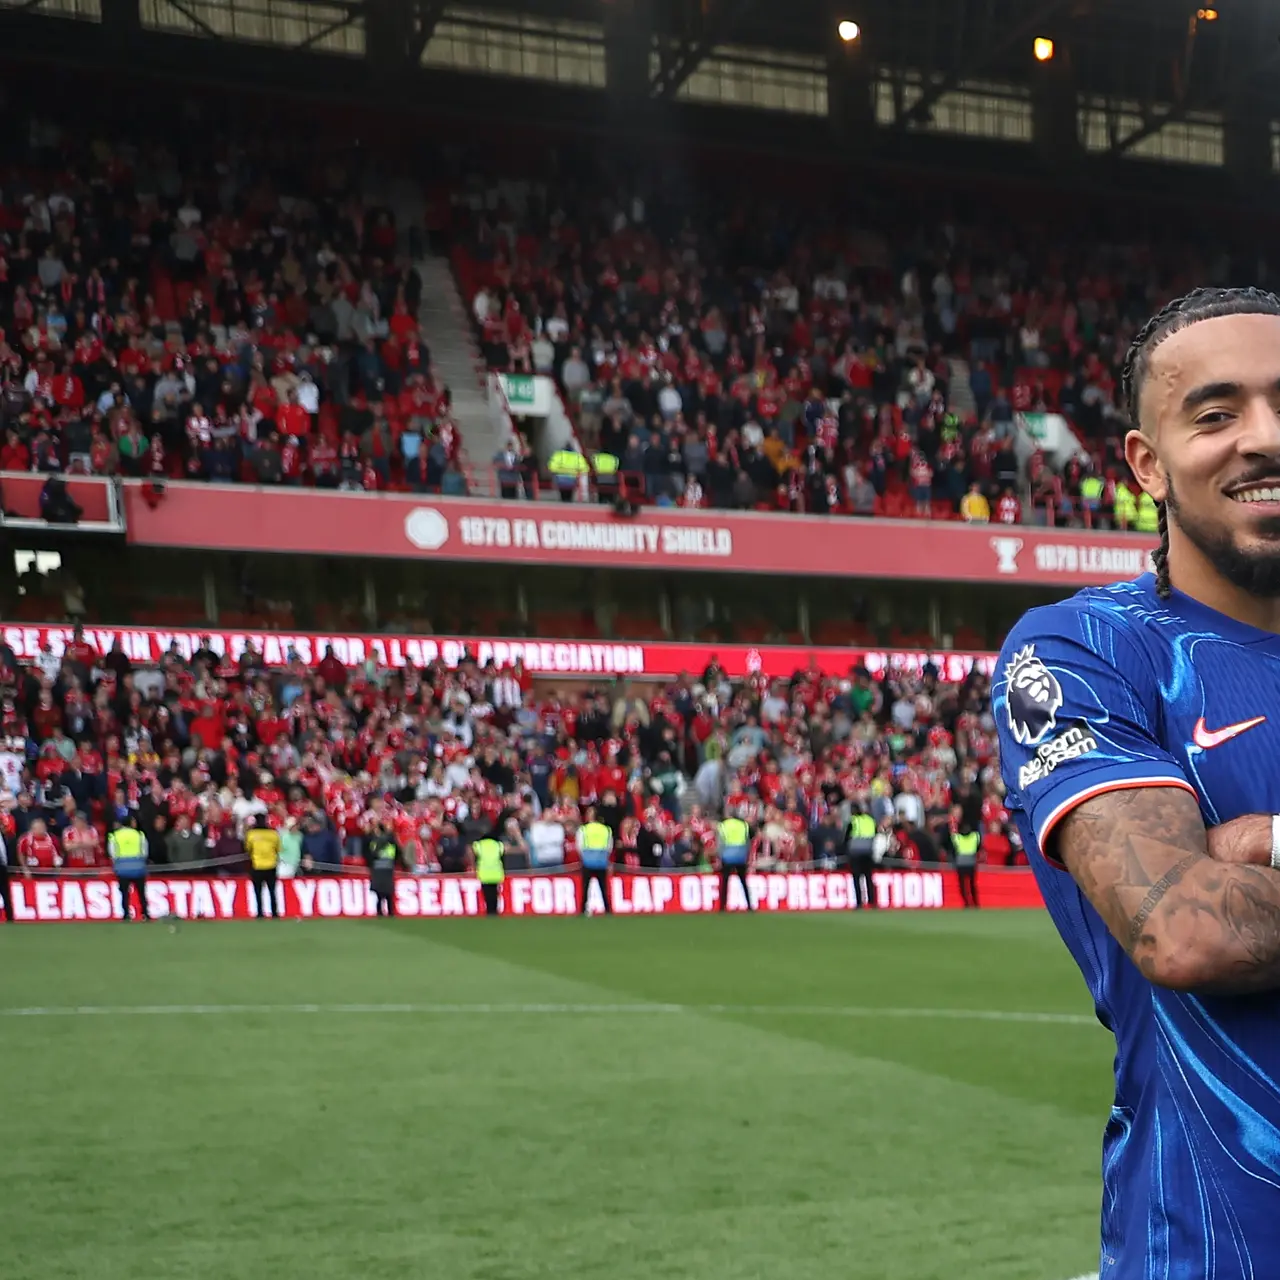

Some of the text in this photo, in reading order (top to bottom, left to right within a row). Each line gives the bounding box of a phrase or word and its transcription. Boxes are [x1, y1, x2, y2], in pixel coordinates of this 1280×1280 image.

[513, 519, 540, 548] FA
[542, 519, 659, 554] COMMUNITY
[662, 525, 733, 557] SHIELD
[1079, 545, 1142, 574] LEAGUE
[477, 642, 645, 673] APPRECIATION
[1038, 727, 1083, 764] room
[1043, 737, 1098, 777] racism
[0, 880, 137, 920] LEASE
[146, 880, 237, 919] STAY
[511, 877, 578, 915] FOR
[610, 876, 674, 914] LAP
[679, 874, 721, 913] OF
[726, 872, 943, 911] APPRECITION
